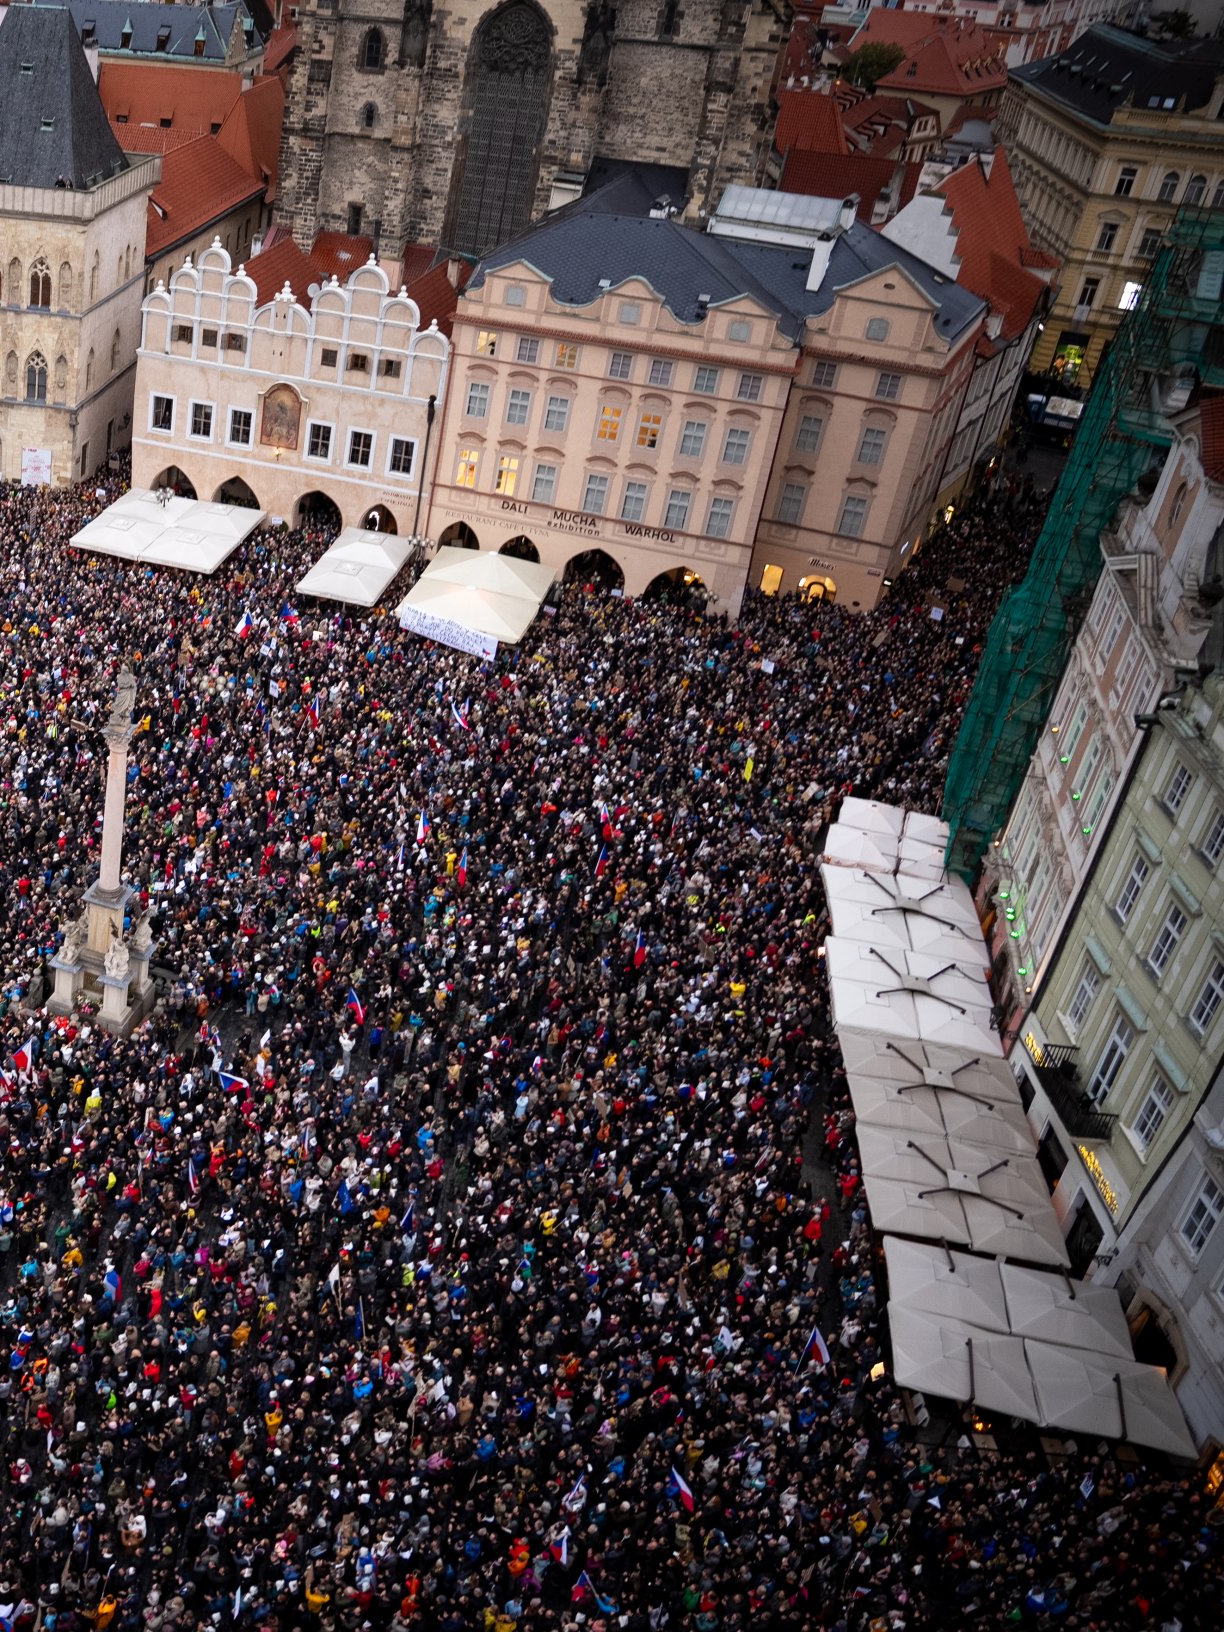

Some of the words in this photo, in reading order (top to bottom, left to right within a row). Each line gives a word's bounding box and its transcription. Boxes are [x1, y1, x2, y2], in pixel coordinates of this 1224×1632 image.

[445, 510, 497, 527] RESTAURANT
[553, 511, 597, 528] MUCHA
[547, 521, 600, 537] exhibition
[625, 525, 676, 543] WARHOL
